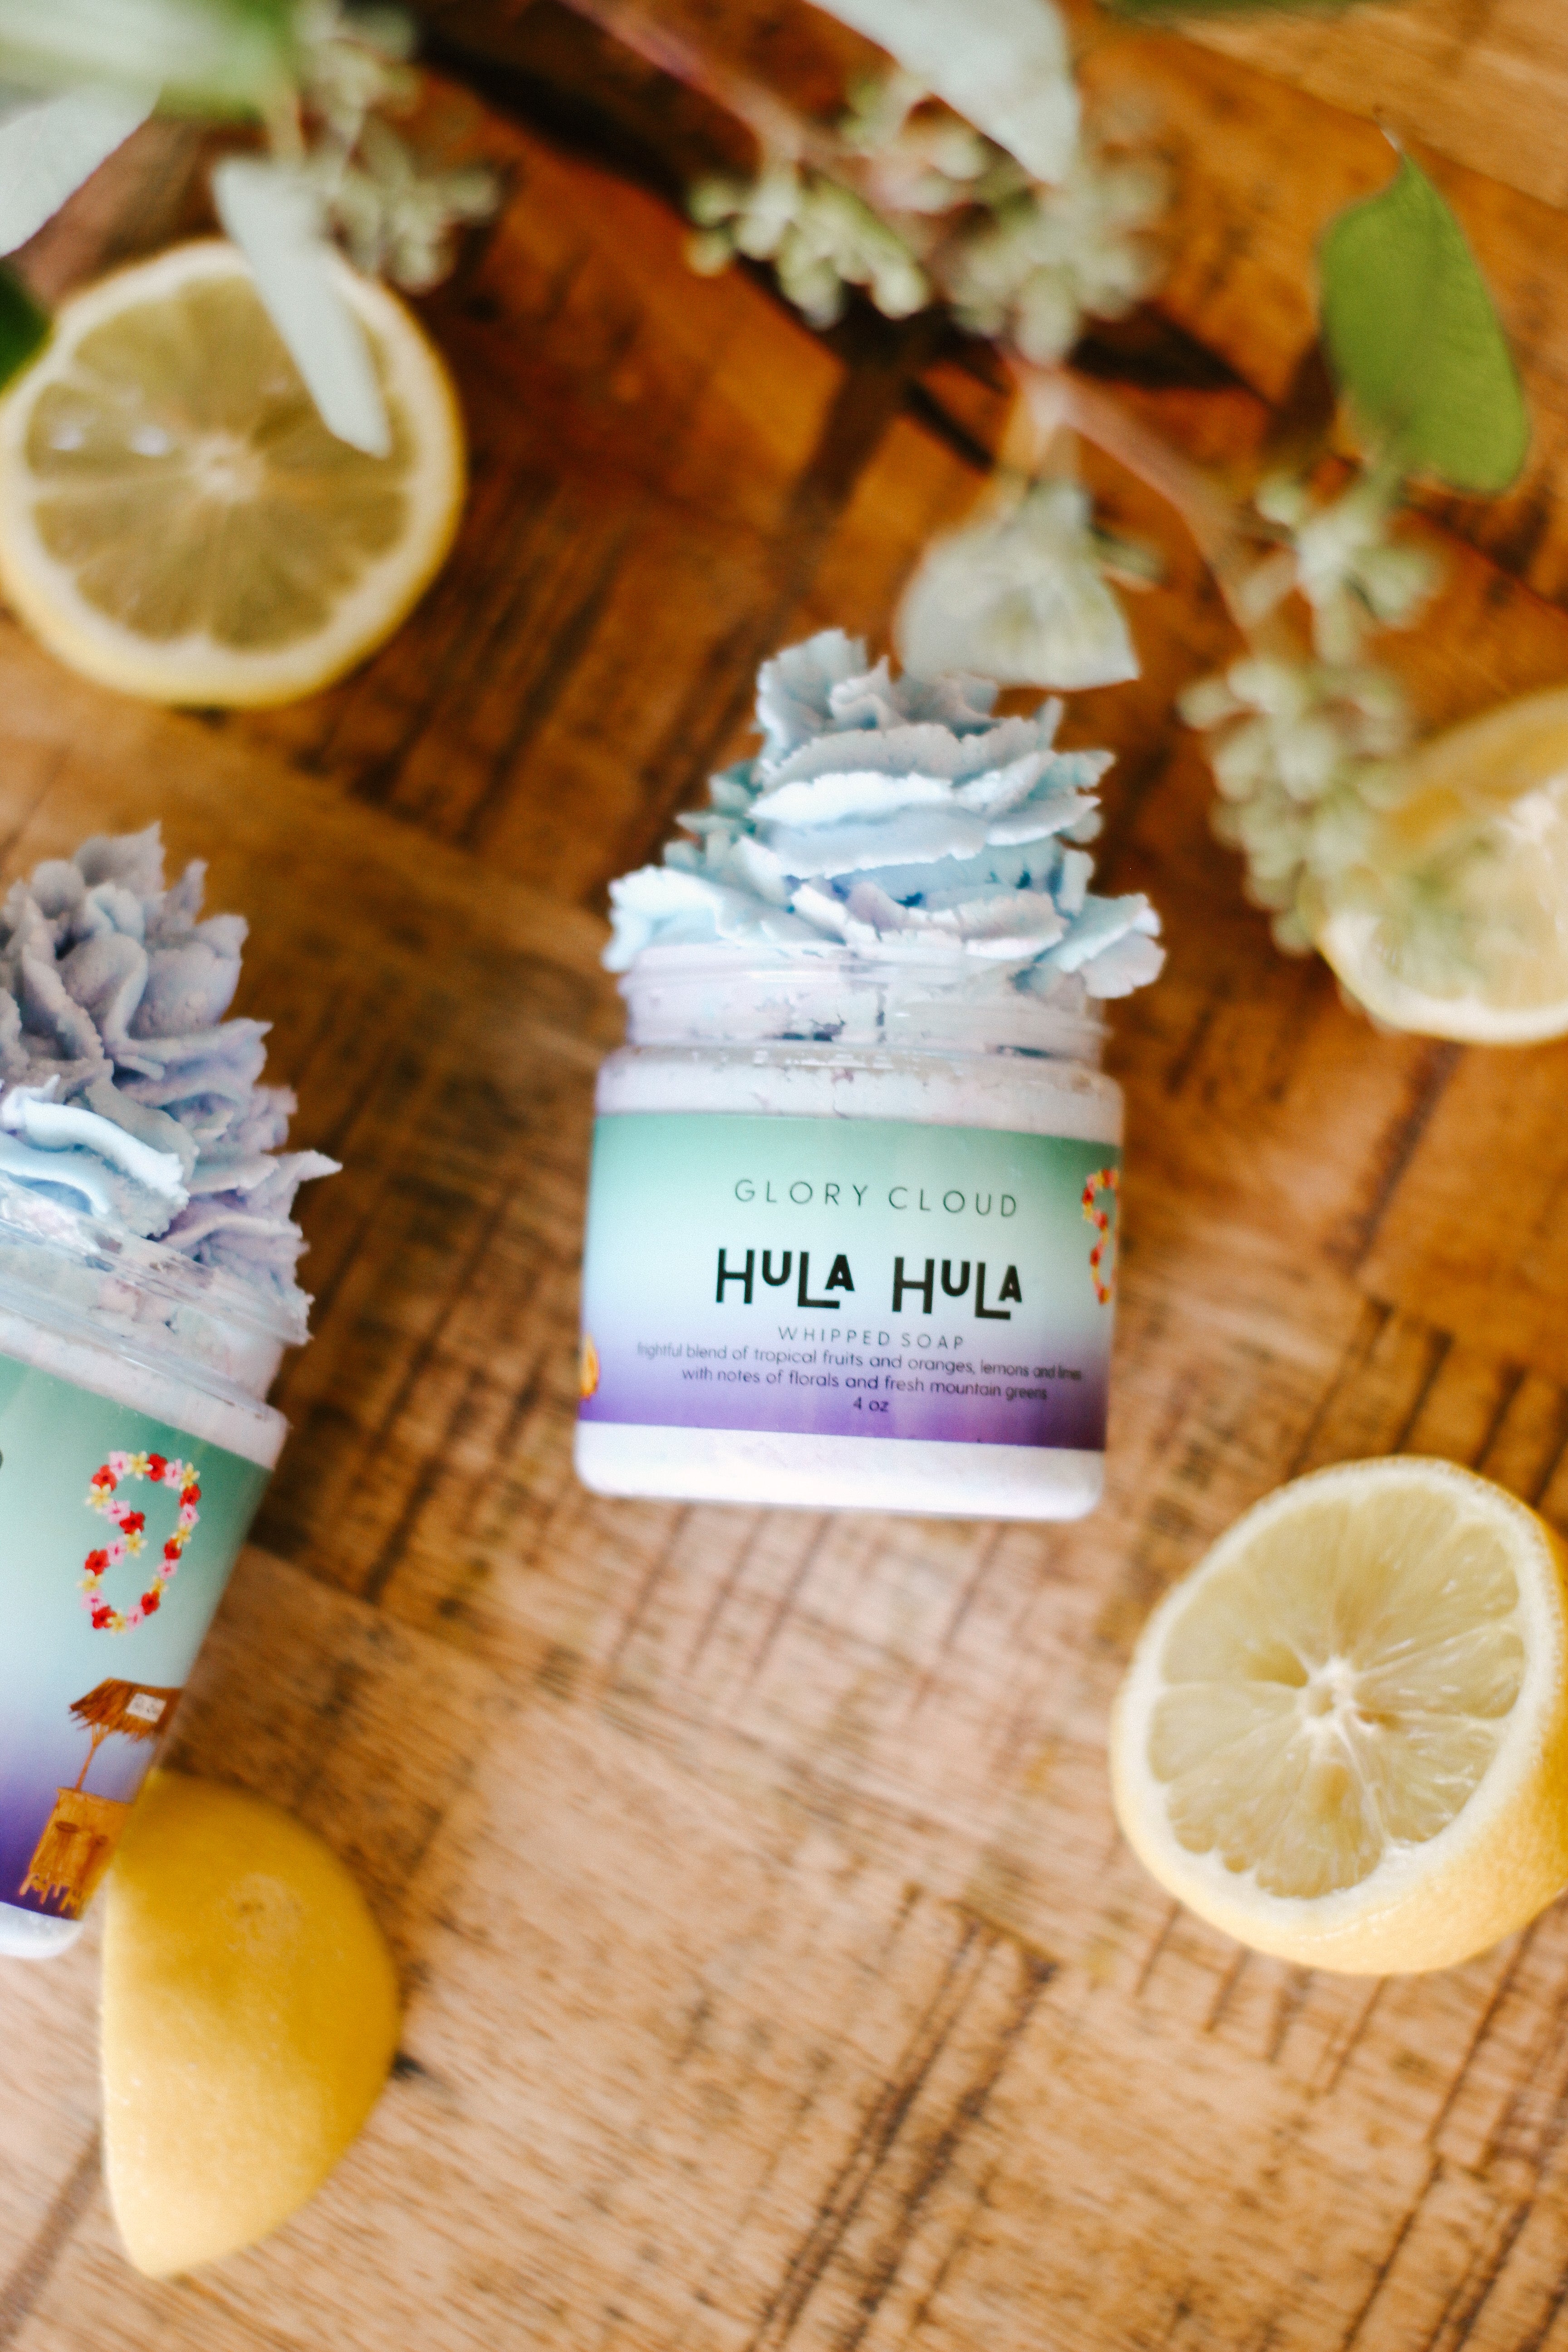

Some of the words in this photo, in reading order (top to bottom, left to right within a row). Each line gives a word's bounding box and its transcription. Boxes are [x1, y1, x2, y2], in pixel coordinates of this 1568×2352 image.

[735, 1180, 868, 1206] GLORY
[888, 1186, 1017, 1218] CLOUD
[715, 1248, 855, 1309] HULA
[892, 1256, 1023, 1320] HULA
[778, 1325, 890, 1347] WHIPPED
[901, 1332, 964, 1350] SOAP
[686, 1343, 727, 1360] blend
[732, 1345, 749, 1361] of
[755, 1348, 817, 1365] tropical
[823, 1349, 863, 1367] fruits
[869, 1354, 902, 1368] and
[908, 1358, 975, 1376] oranges,
[980, 1359, 1029, 1377] lemons
[1033, 1364, 1056, 1379] and
[682, 1366, 712, 1381] with
[716, 1369, 761, 1383] notes
[766, 1369, 783, 1384] of
[789, 1369, 839, 1387] florals
[845, 1375, 878, 1390] and
[885, 1374, 925, 1392] fresh
[930, 1381, 1002, 1396] mountain
[1005, 1387, 1048, 1402] greens
[853, 1396, 862, 1410] 4
[868, 1400, 889, 1412] oz
